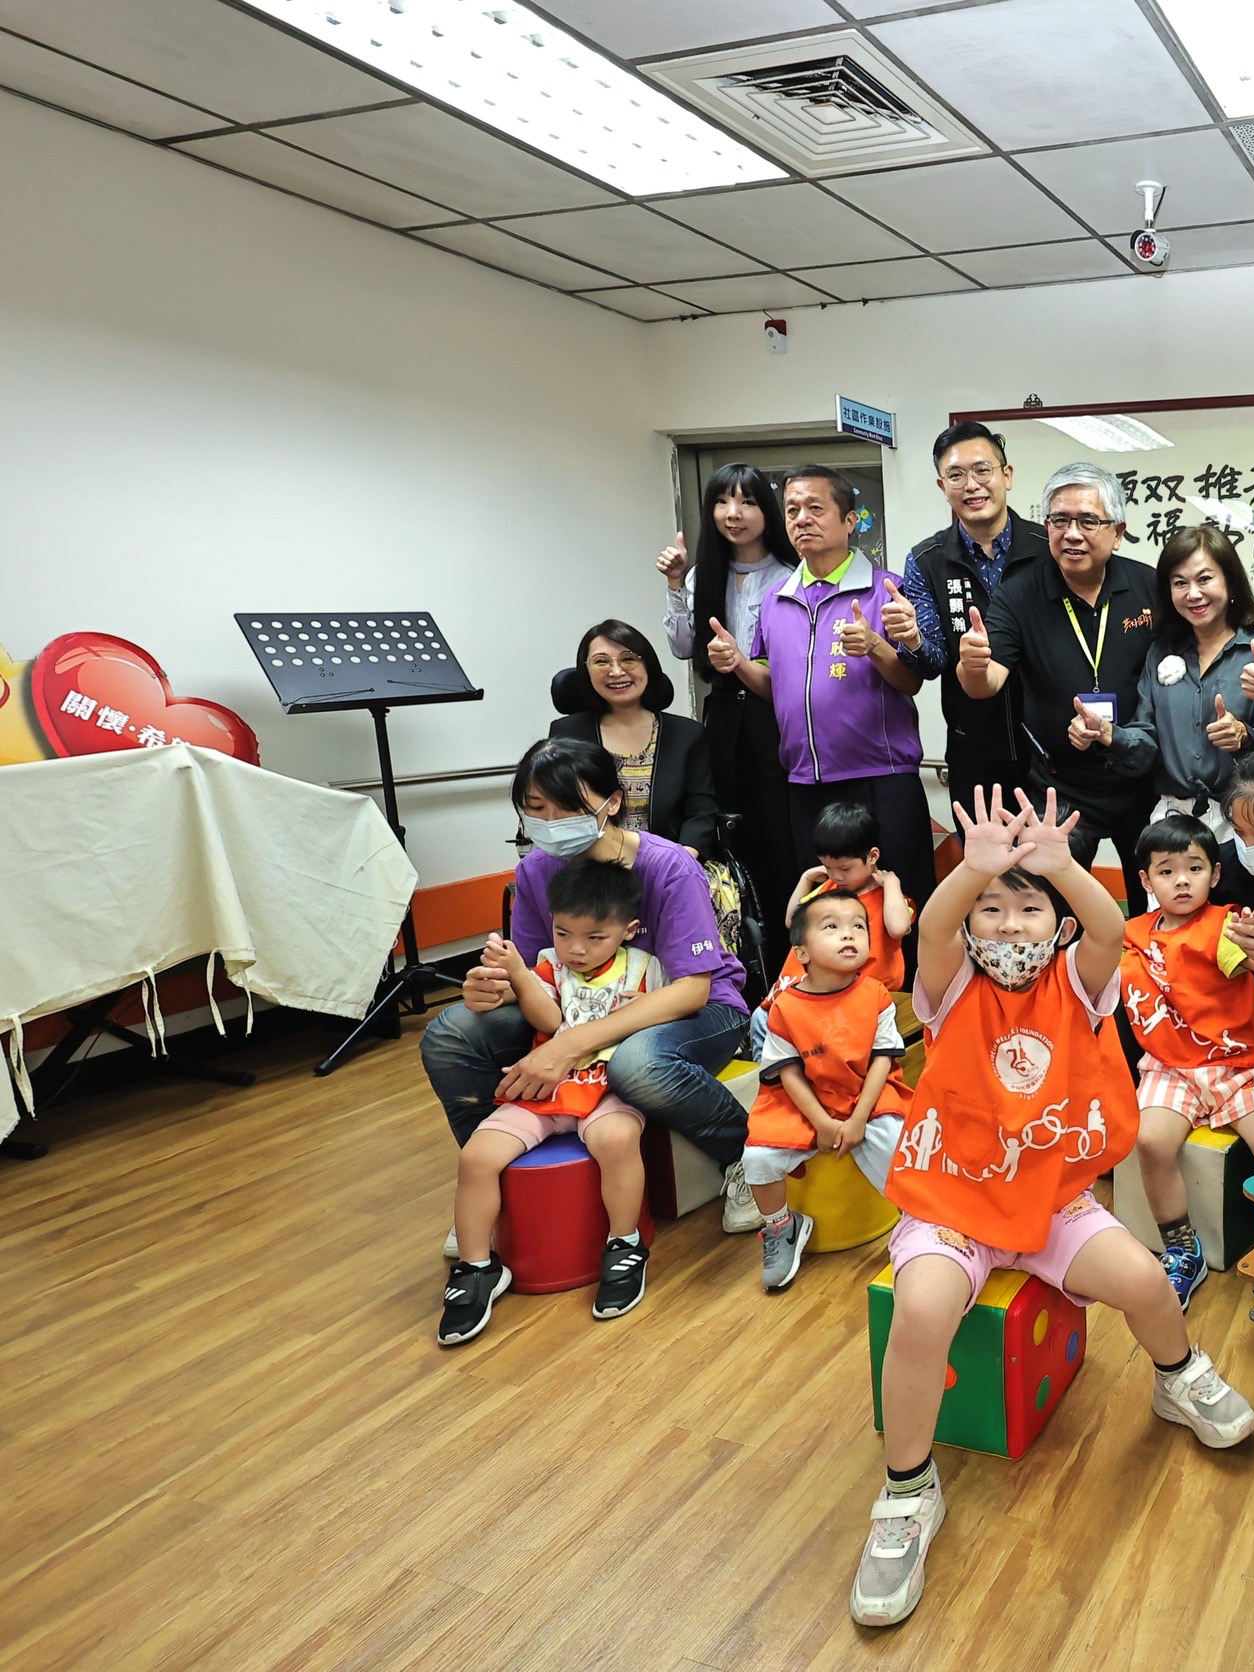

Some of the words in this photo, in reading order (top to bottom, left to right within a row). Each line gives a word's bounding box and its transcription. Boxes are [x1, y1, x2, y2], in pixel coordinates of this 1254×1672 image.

[842, 406, 891, 433] 社區作業設施
[691, 939, 714, 956] 伊甸
